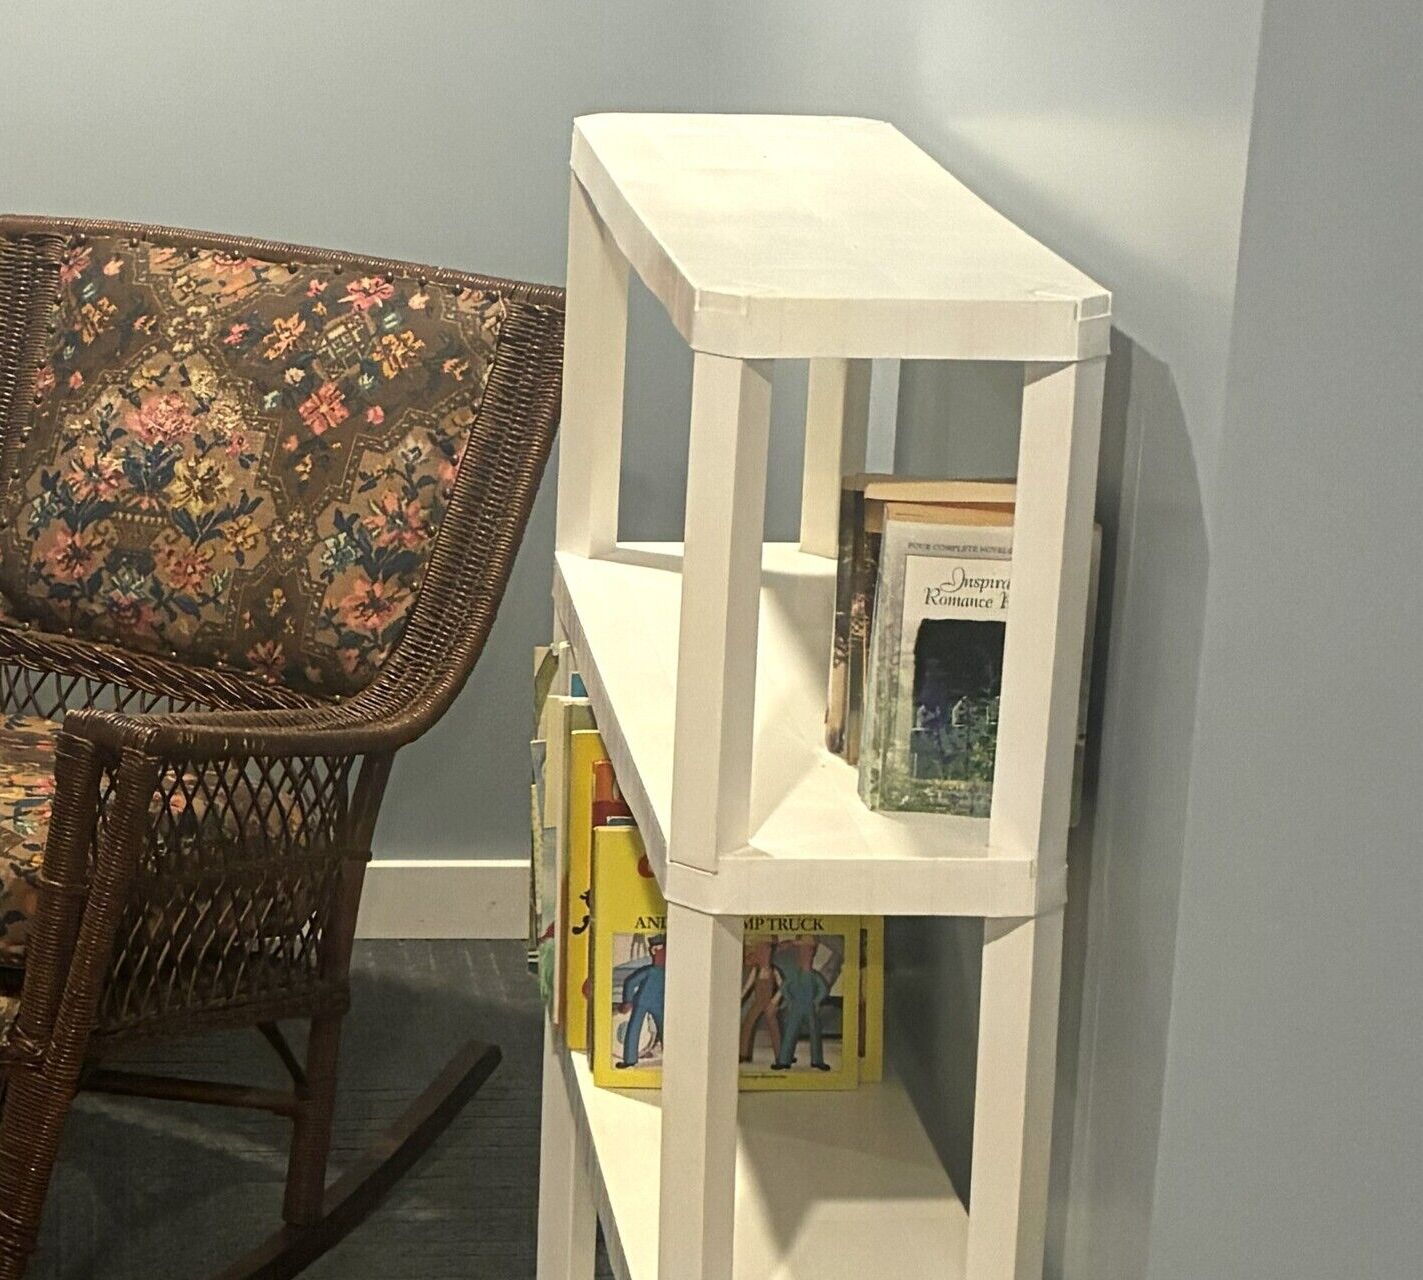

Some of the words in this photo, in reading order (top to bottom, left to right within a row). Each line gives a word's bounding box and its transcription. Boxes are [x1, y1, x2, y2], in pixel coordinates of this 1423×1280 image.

[939, 567, 1011, 593] Inspira
[924, 587, 994, 609] Romance
[768, 917, 825, 931] TRUCK
